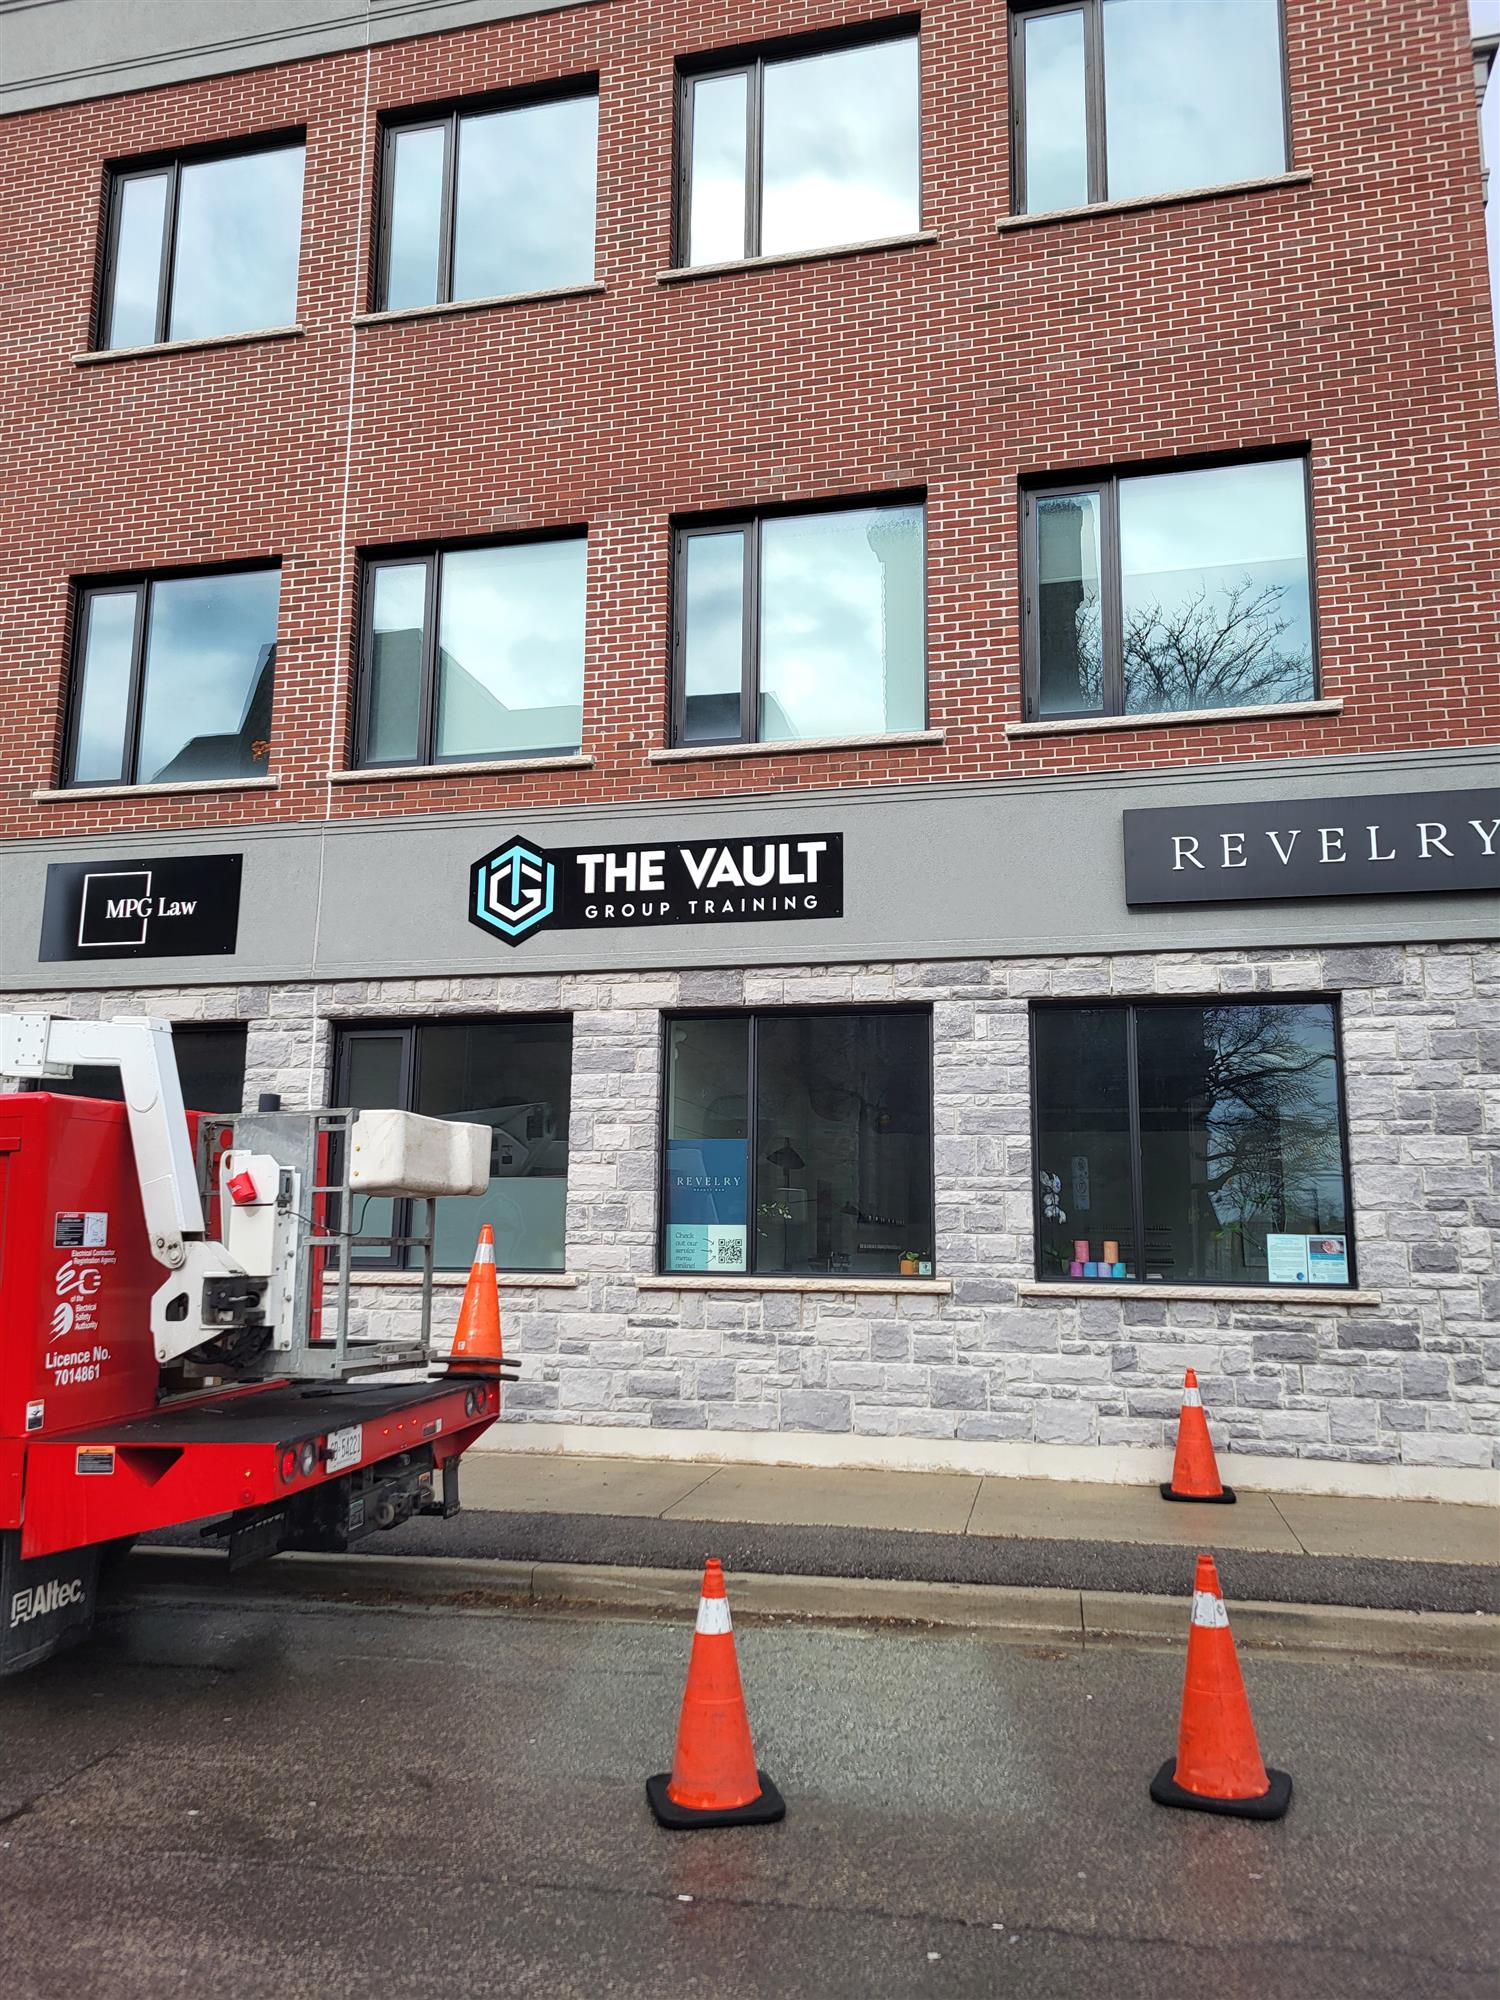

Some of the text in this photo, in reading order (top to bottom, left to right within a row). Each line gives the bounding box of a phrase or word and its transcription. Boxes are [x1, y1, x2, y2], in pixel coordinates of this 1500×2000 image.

[1170, 819, 1500, 871] REVELRY
[576, 841, 827, 895] THE VAULT
[105, 897, 198, 919] MPG Law
[585, 895, 818, 919] GROUP TRAINING
[676, 1176, 742, 1187] REVELRY
[675, 1231, 695, 1239] Check
[45, 1345, 112, 1369] Licence No.
[55, 1363, 100, 1387] 7014861
[32, 1578, 82, 1619] Altec
